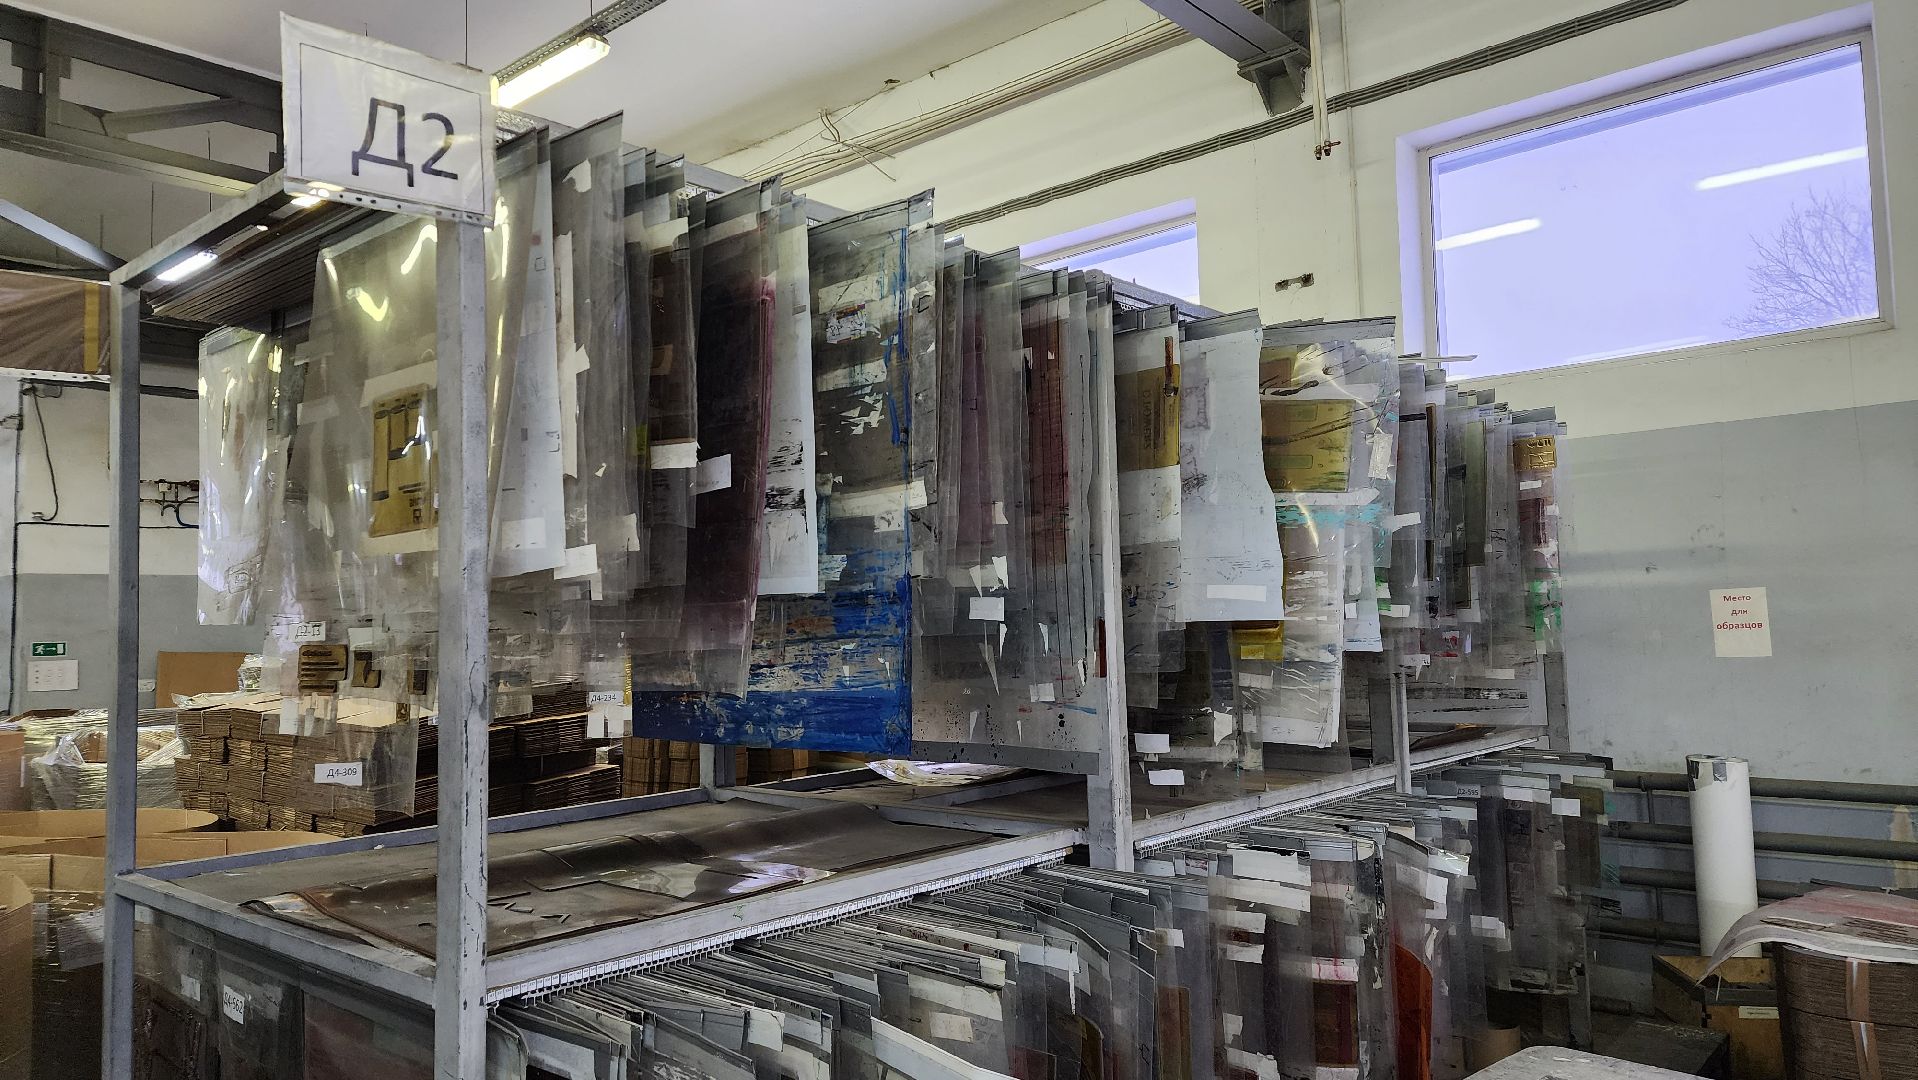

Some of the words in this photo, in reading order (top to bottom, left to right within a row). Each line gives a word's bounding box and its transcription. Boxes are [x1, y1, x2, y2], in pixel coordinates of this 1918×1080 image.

[352, 97, 458, 187] Д2
[1731, 608, 1748, 616] для
[1716, 621, 1763, 631] образцов
[327, 767, 357, 778] Д4-309
